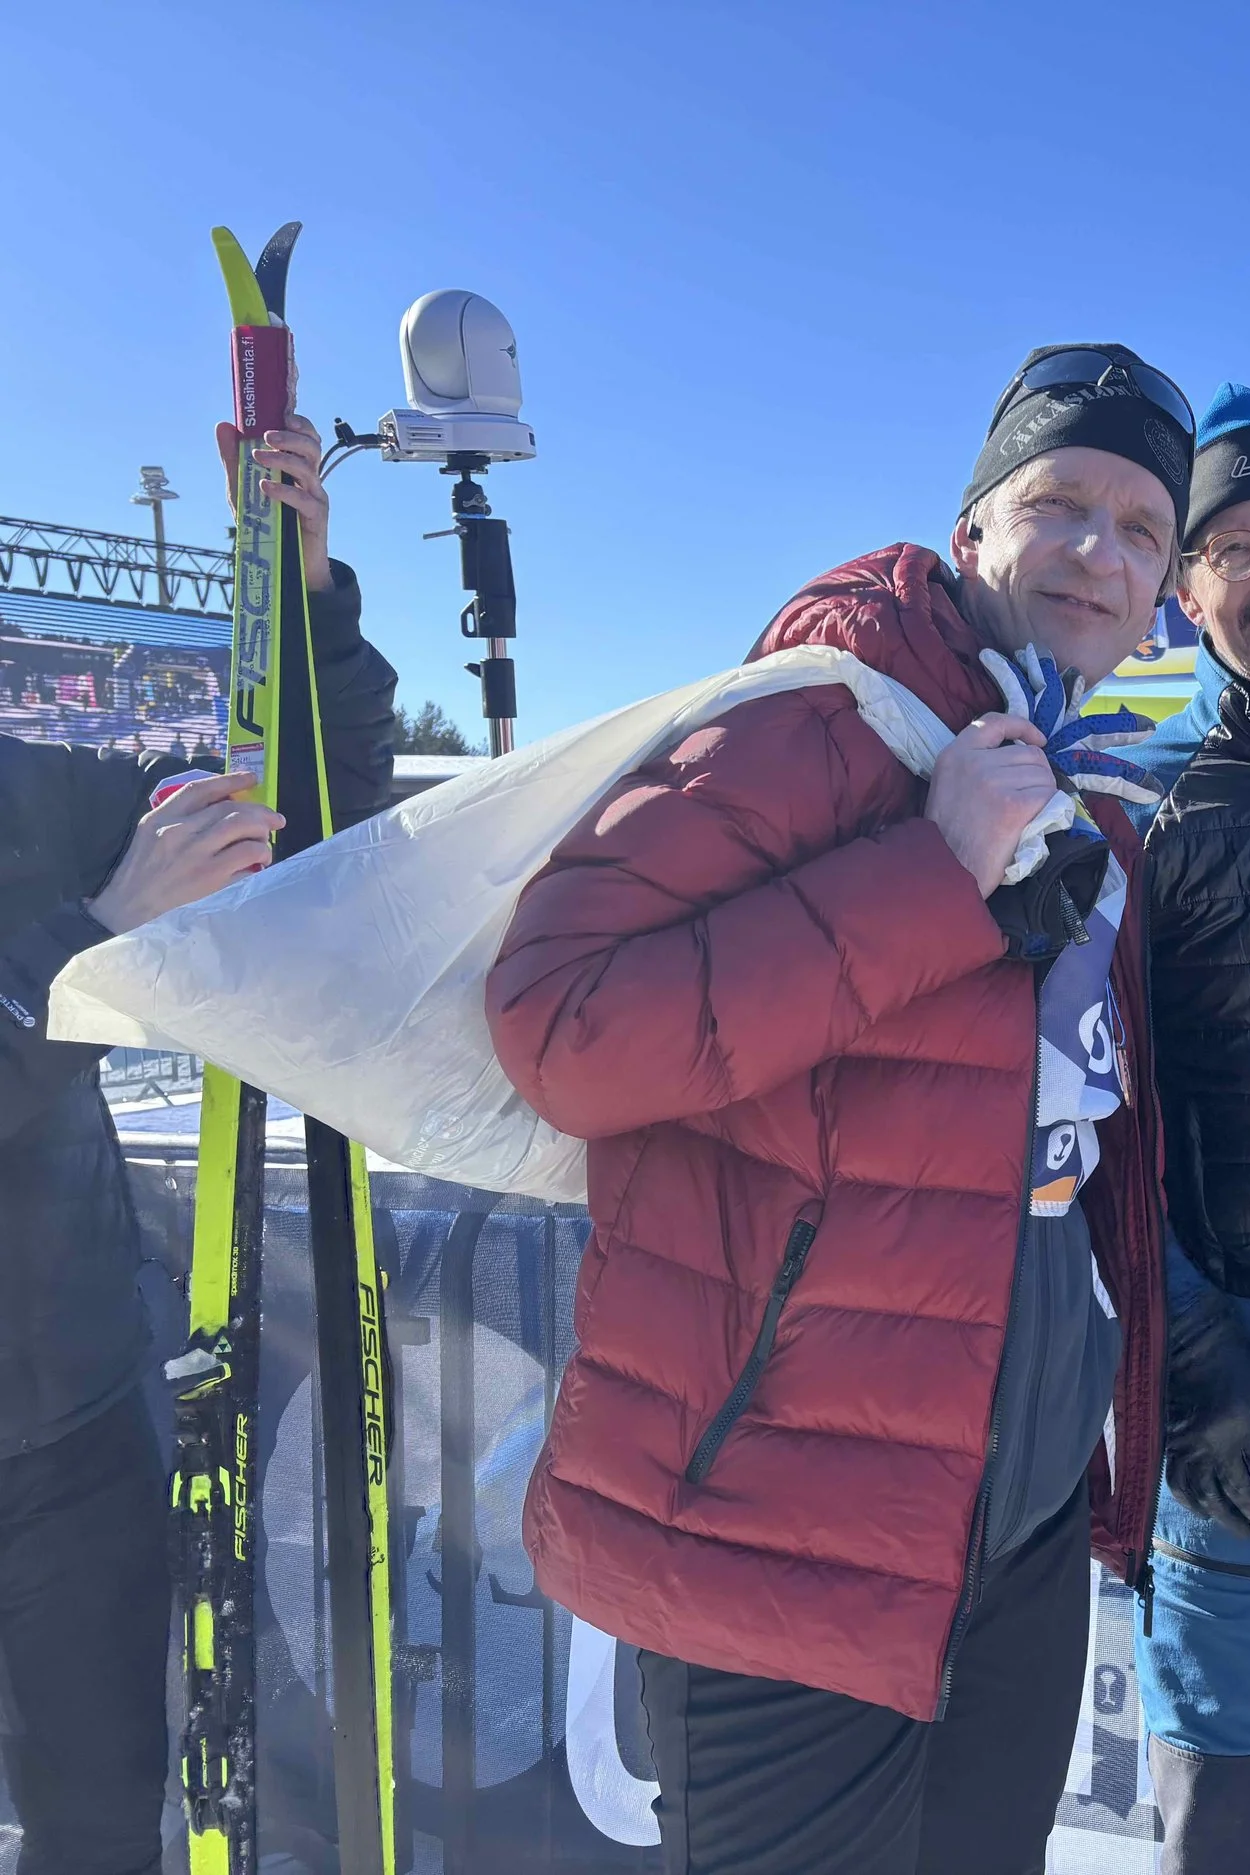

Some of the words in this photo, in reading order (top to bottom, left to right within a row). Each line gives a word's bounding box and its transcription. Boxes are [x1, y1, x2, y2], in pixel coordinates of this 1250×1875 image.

[241, 335, 257, 427] Suksihionta.fi
[236, 438, 272, 738] FISCHE
[358, 1283, 386, 1486] FISCHER
[234, 1412, 248, 1561] FISCHER
